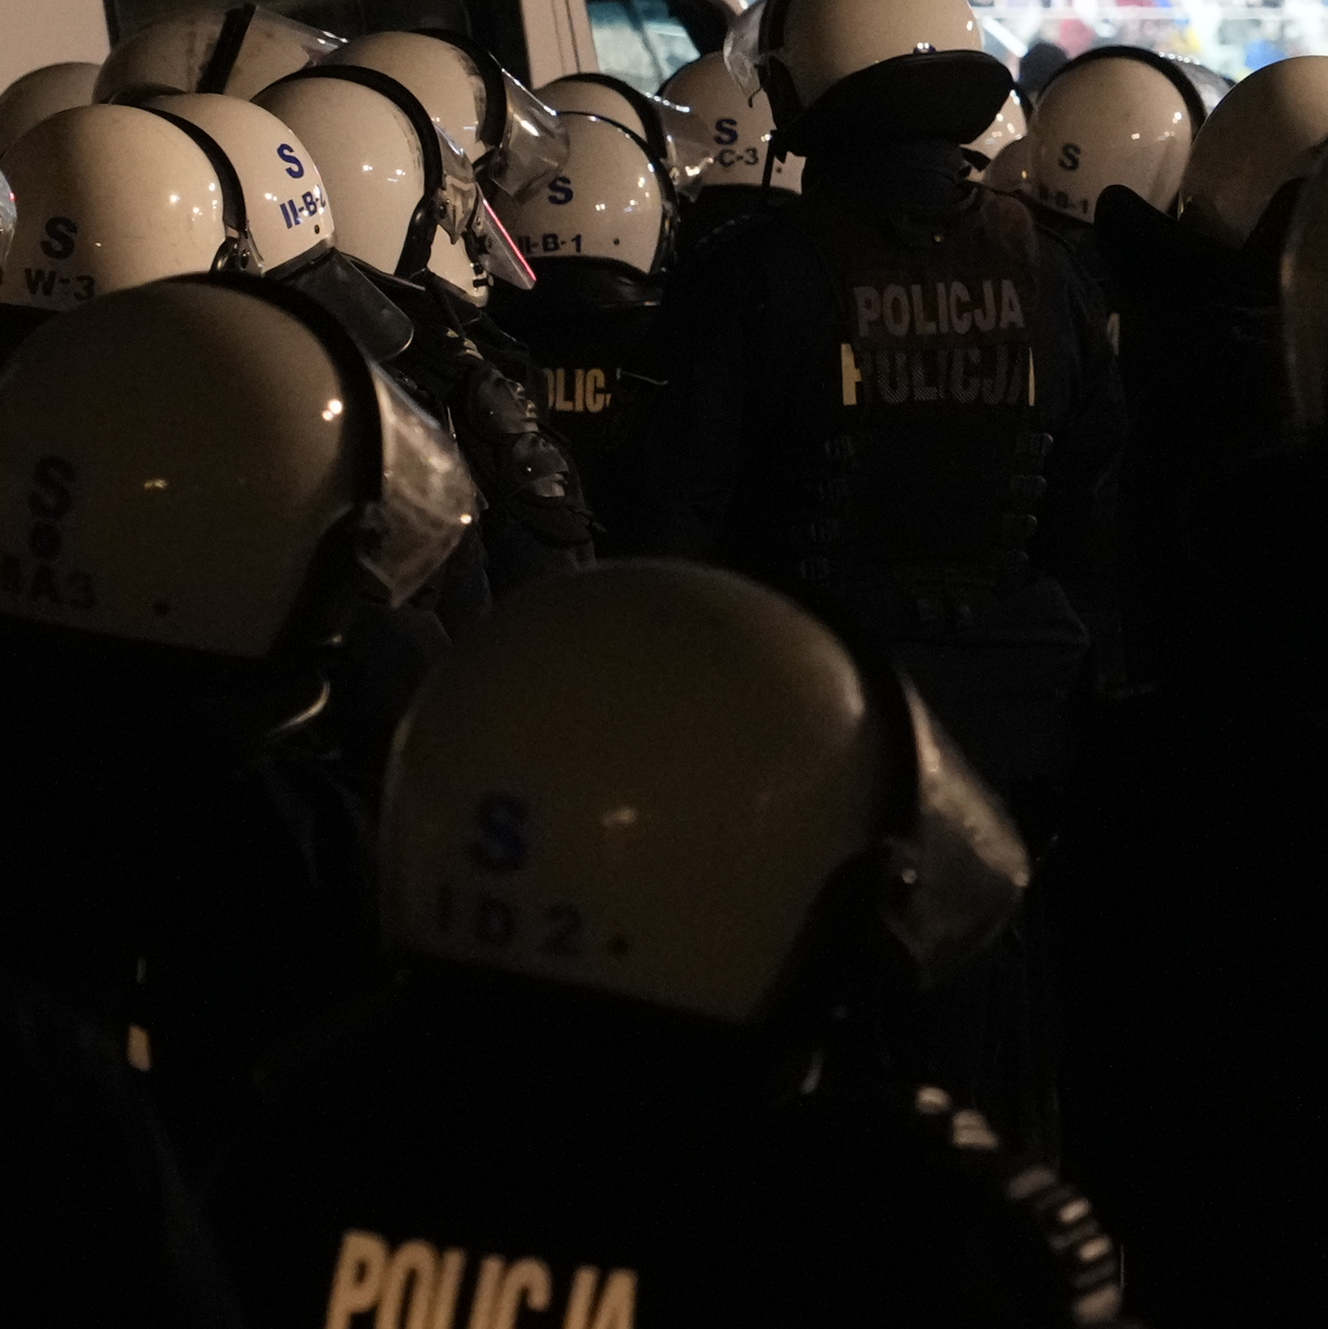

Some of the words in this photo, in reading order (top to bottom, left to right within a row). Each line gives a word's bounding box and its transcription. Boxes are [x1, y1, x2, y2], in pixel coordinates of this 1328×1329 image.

[714, 117, 738, 145] S
[277, 143, 304, 179] S
[1058, 143, 1081, 170] S
[548, 176, 574, 205] S
[41, 216, 78, 260] S
[852, 278, 1026, 338] POLICJA
[28, 456, 75, 521] S
[468, 791, 528, 872] S
